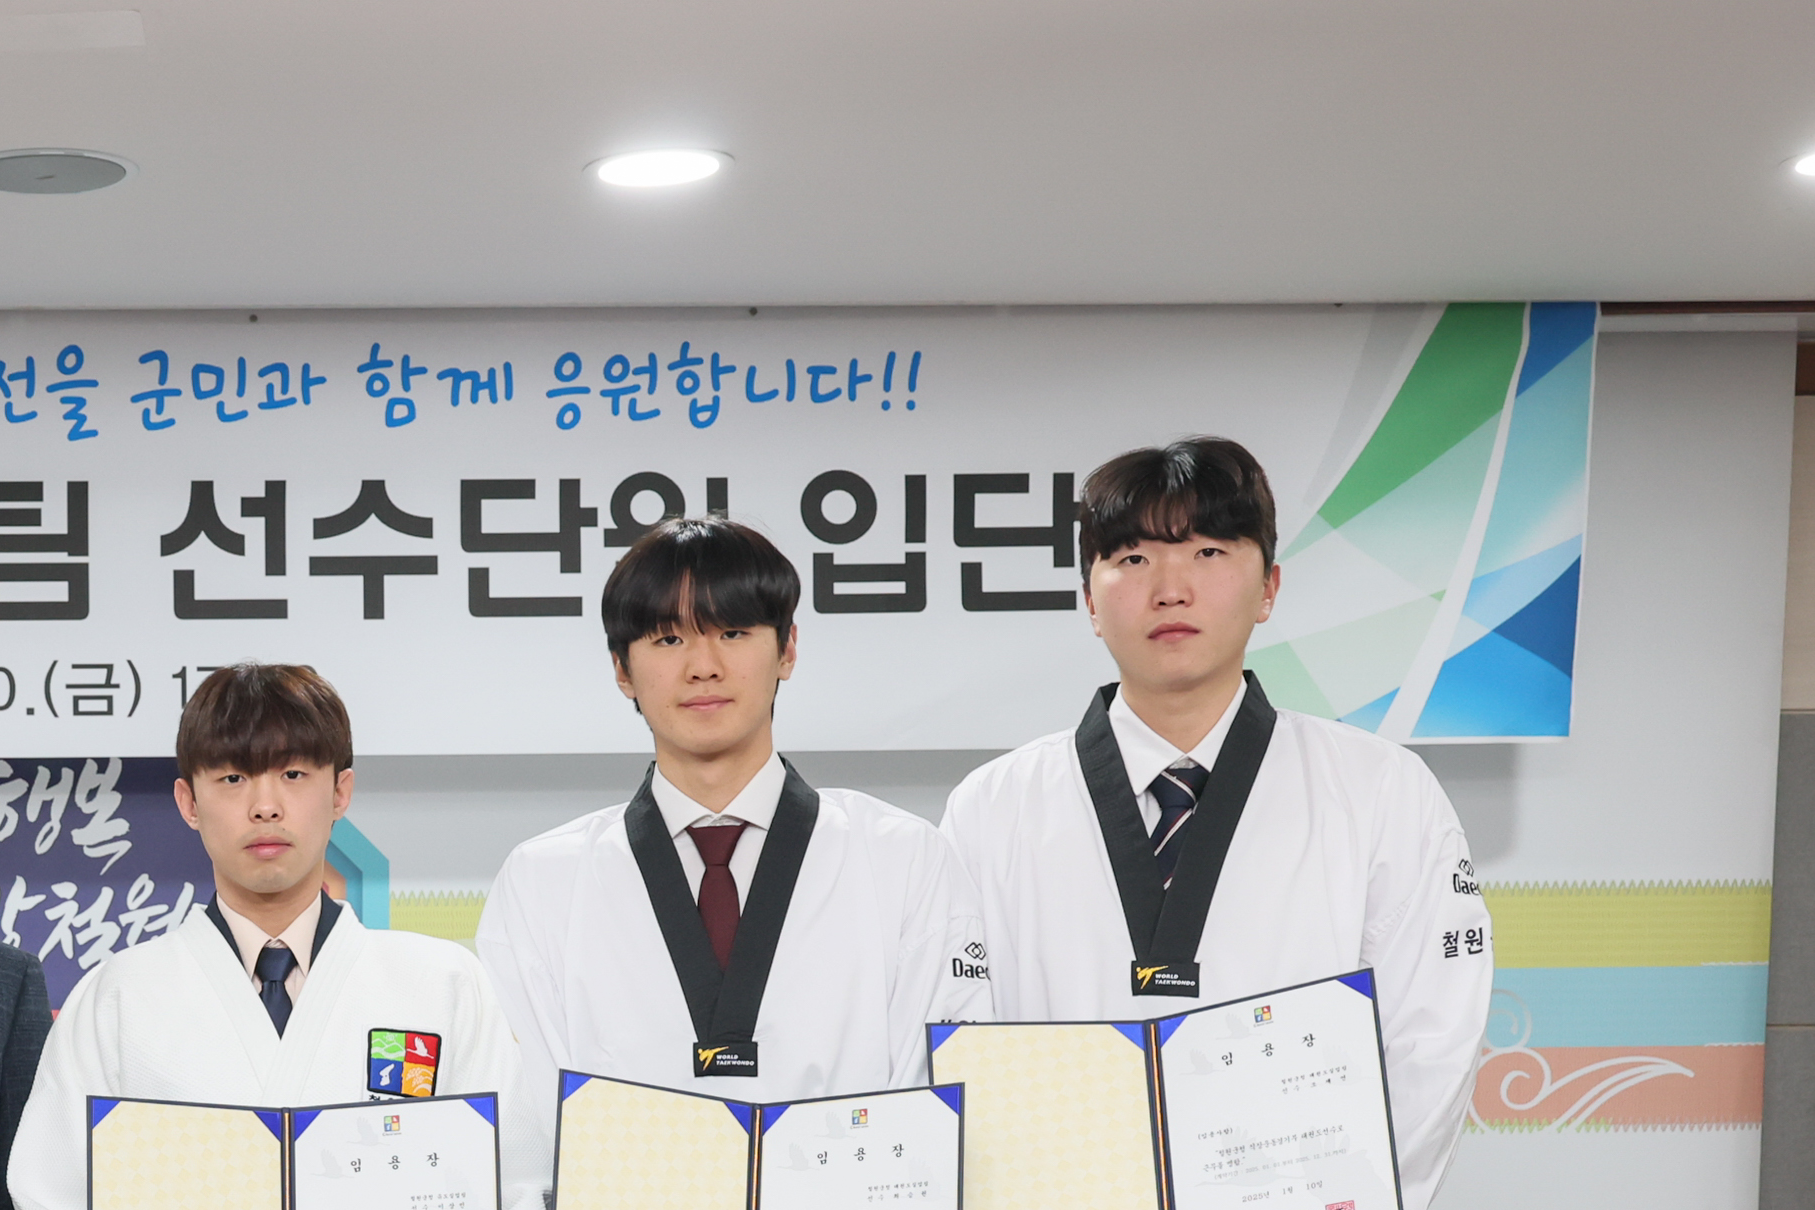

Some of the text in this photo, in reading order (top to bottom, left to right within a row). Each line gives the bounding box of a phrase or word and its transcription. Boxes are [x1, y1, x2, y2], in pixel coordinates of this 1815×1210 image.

[132, 351, 328, 432] 군민과
[358, 345, 514, 428] 함께
[548, 343, 922, 431] 응원합니다!!
[1155, 979, 1196, 987] TAEKWONDO
[1242, 1191, 1270, 1203] 2025년
